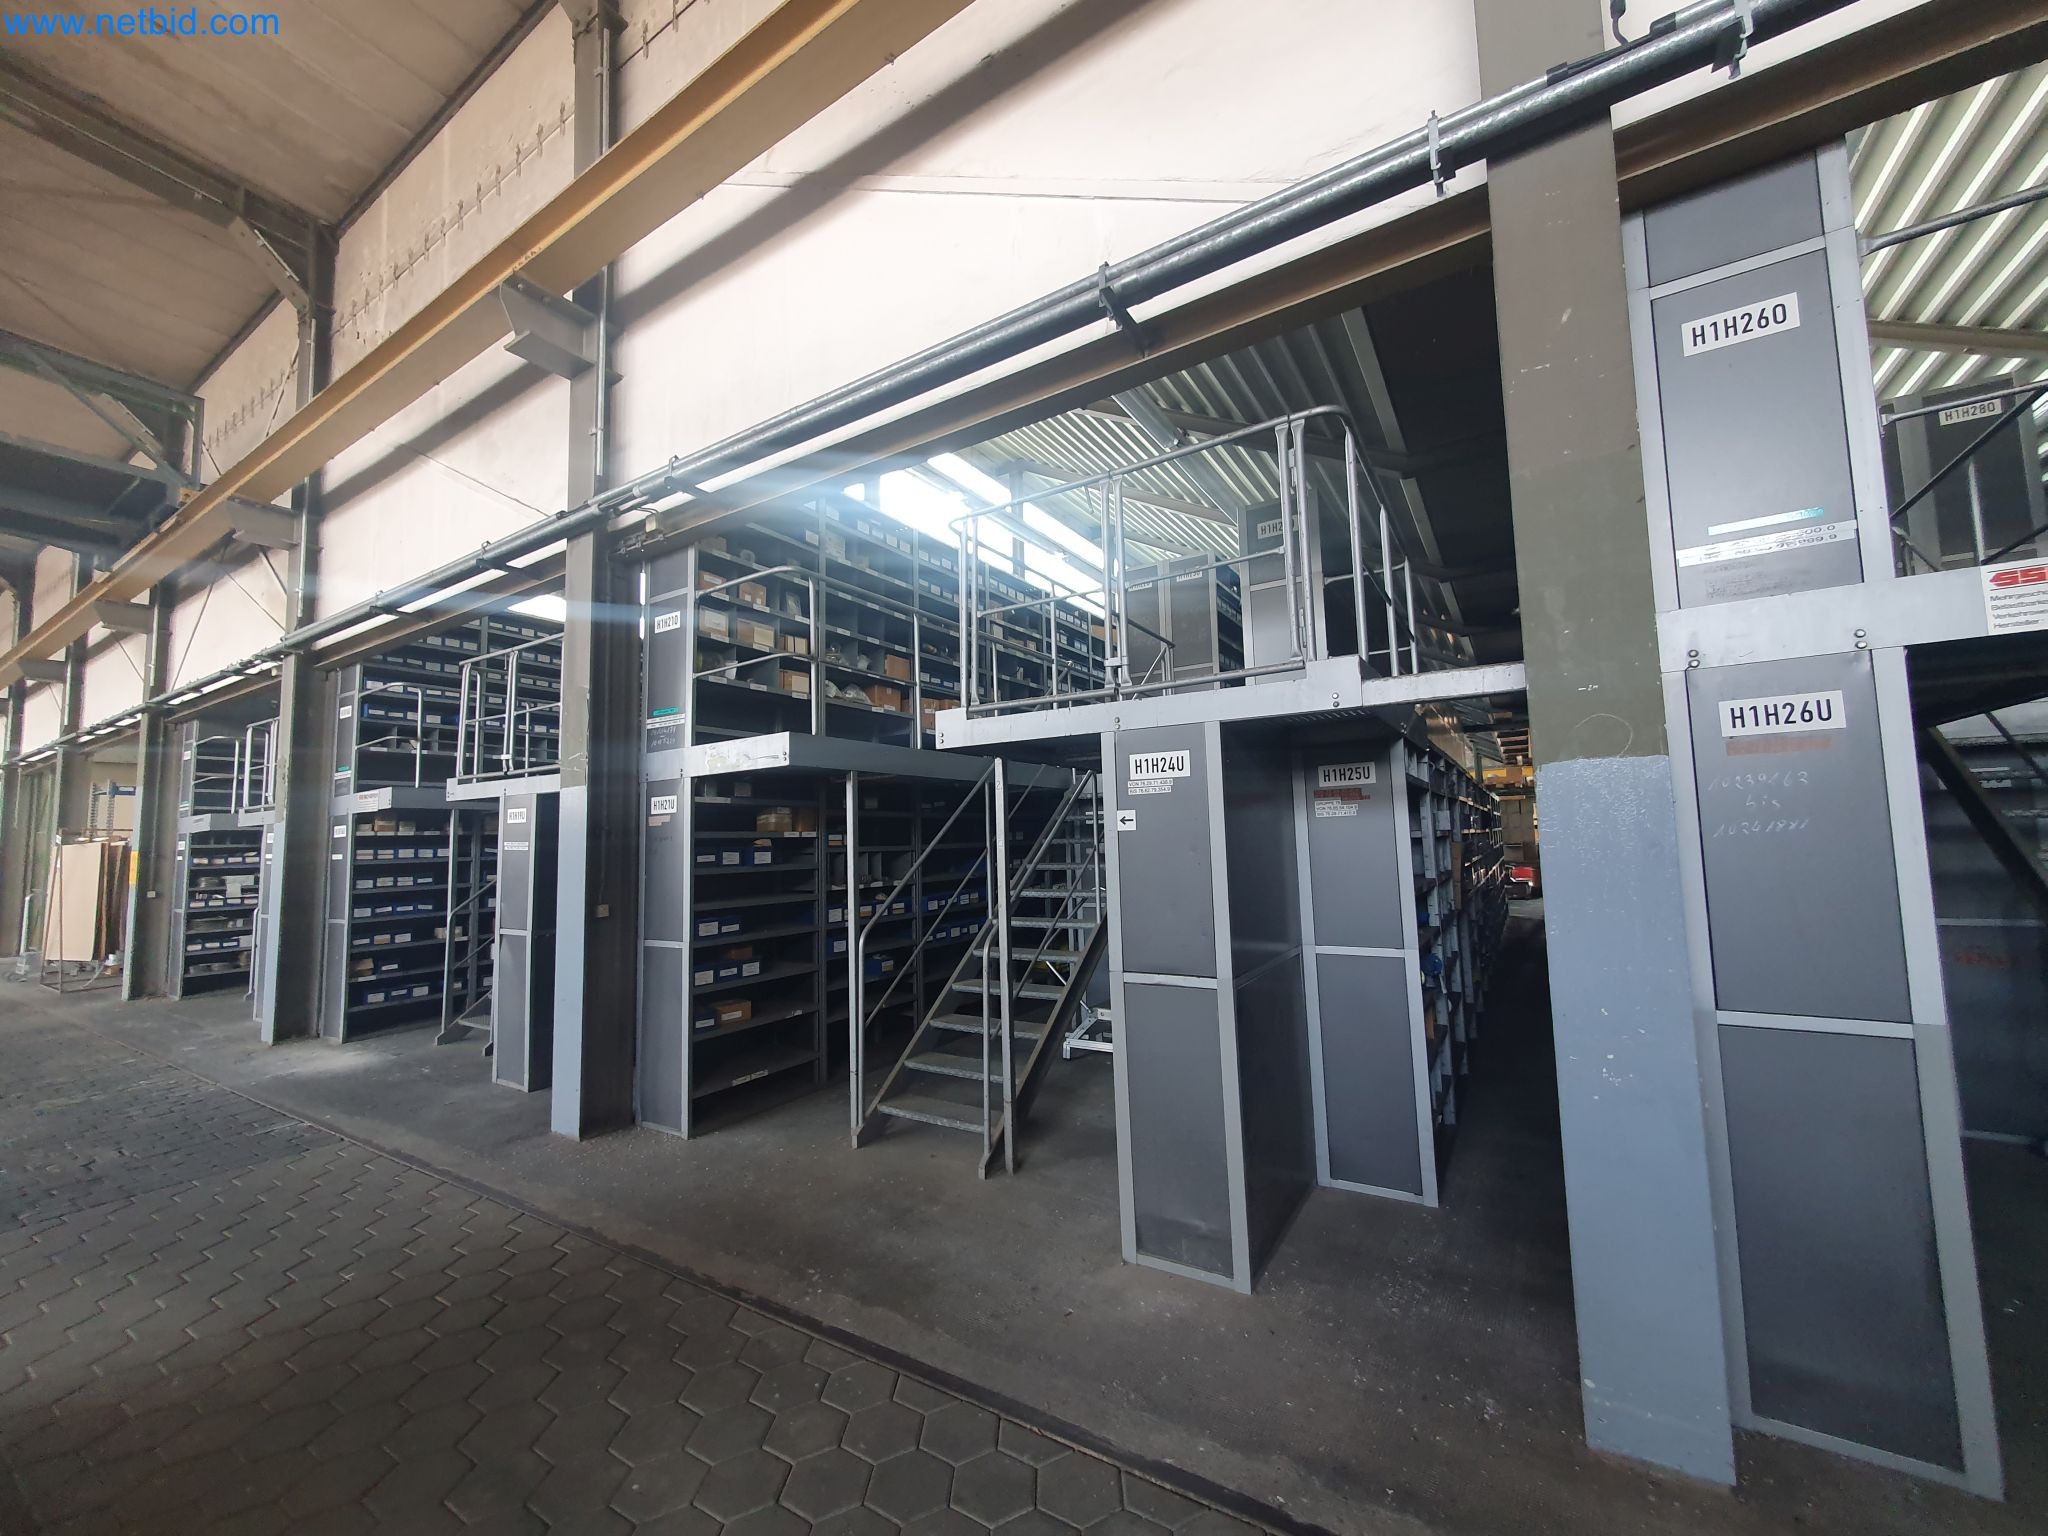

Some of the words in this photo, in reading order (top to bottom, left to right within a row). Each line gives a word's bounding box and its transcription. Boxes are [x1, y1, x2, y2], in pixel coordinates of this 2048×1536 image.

[1730, 698, 1833, 729] H1H26U
[1134, 755, 1185, 775] H1H24U
[1323, 765, 1371, 783] H1H25U
